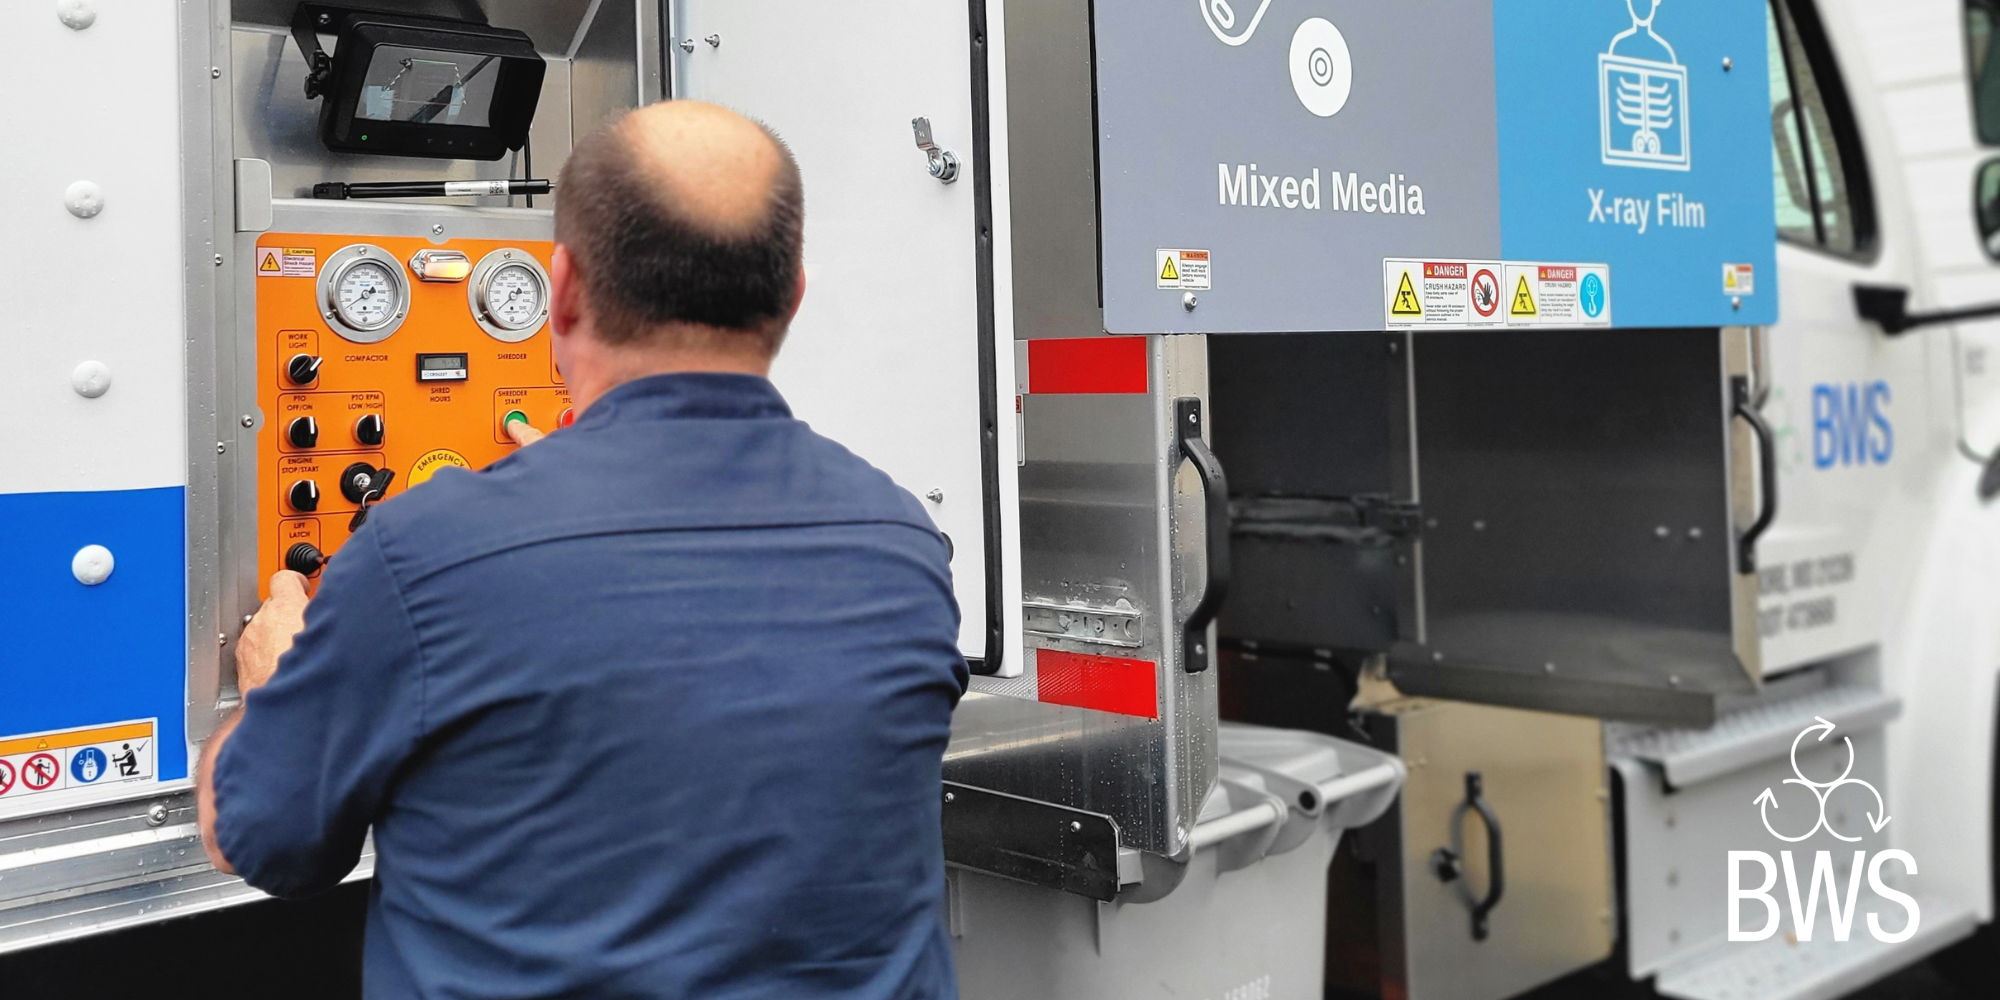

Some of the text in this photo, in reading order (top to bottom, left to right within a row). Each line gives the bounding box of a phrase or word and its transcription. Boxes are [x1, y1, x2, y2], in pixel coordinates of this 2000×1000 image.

[1218, 163, 1426, 216] Mixed Media
[1587, 187, 1706, 235] X-ray Film
[1434, 265, 1465, 276] DANGER
[1547, 268, 1574, 279] DANGER
[498, 389, 527, 397] SHREDDER
[286, 404, 313, 412] OFF/ON
[1812, 379, 1894, 471] BWS
[287, 457, 313, 465] ENGINE
[417, 453, 465, 471] EMERGENCY
[281, 466, 319, 474] STOP/START
[289, 531, 311, 539] LATCH
